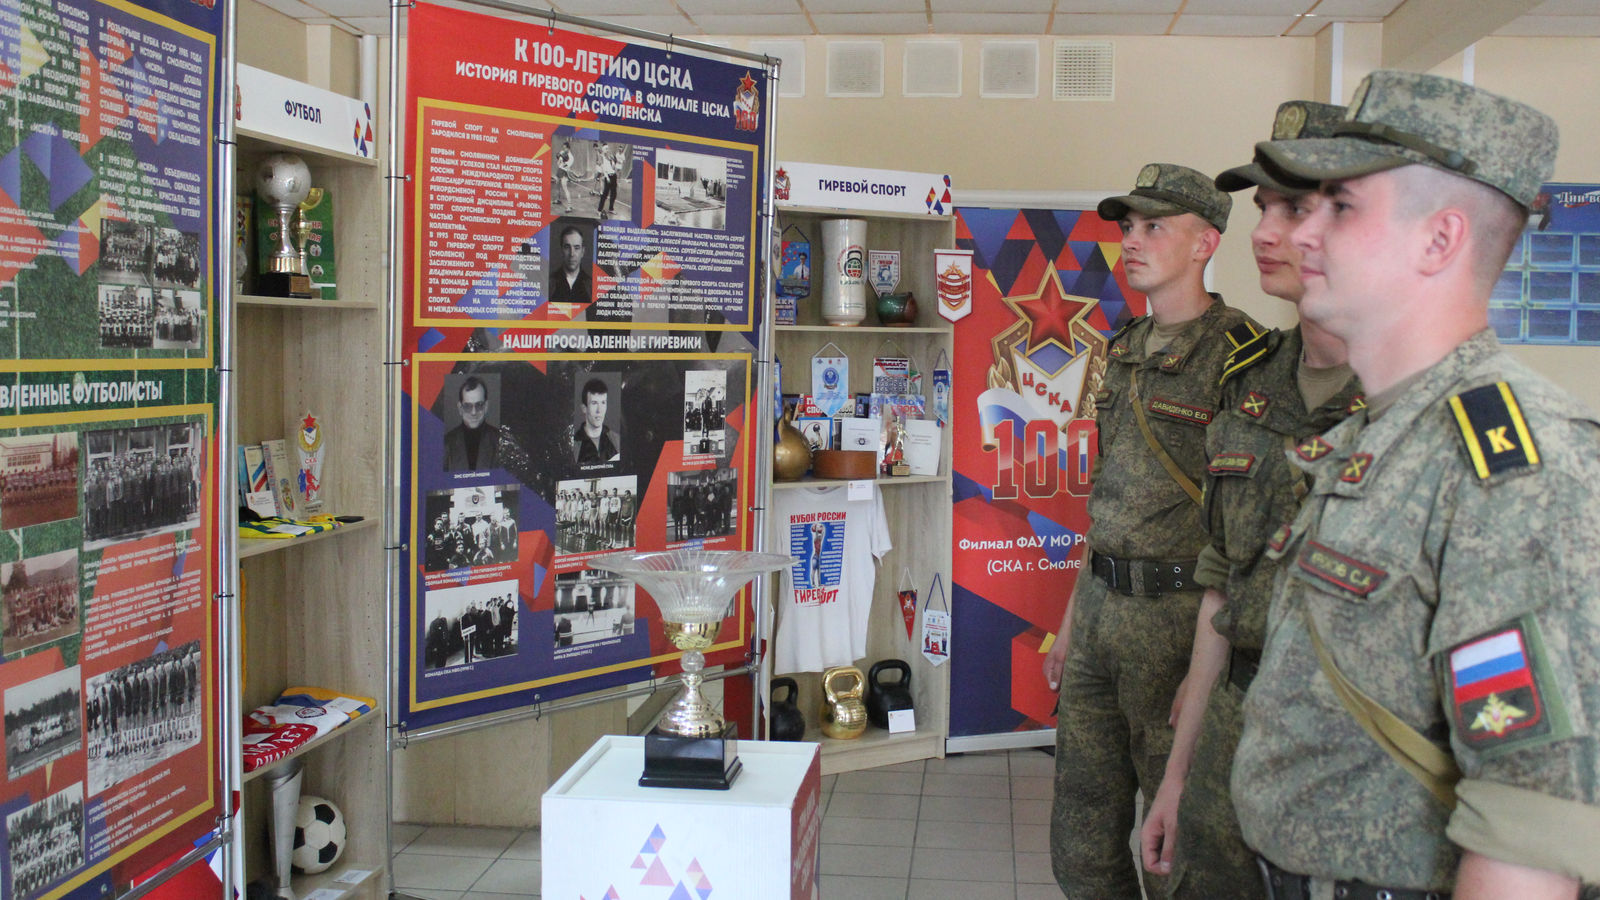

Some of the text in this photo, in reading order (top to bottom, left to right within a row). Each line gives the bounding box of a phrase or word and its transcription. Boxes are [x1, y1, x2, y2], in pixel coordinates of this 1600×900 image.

[514, 38, 693, 92] К 100-ЛЕТИЮ ЦСКА
[456, 60, 730, 119] ИСТОРИЯ ГИРЕВОГО СПОРТА В ФИЛИАЛЕ ЦСКА
[285, 100, 322, 124] ФУТБОЛ
[541, 92, 662, 124] ГОРОДА СМОЛЕНСКА
[818, 179, 906, 196] ГИРЕВОЙ СПОРТ
[503, 334, 701, 350] НАШИ ПРОСЛАВЛЕННЫЕ ГИРЕВИКИ
[73, 381, 162, 404] ФУТБОЛИСТЫ
[1023, 373, 1072, 413] ЦСКА
[1152, 401, 1193, 416] ДАВИДЕНКО
[1485, 426, 1516, 454] К
[992, 419, 1098, 500] 100
[790, 512, 846, 523] КУБОК РОССИИ
[959, 538, 1012, 550] Филиал
[1017, 536, 1046, 548] ФАУ
[1051, 535, 1071, 547] МО
[987, 560, 1023, 575] (СКА
